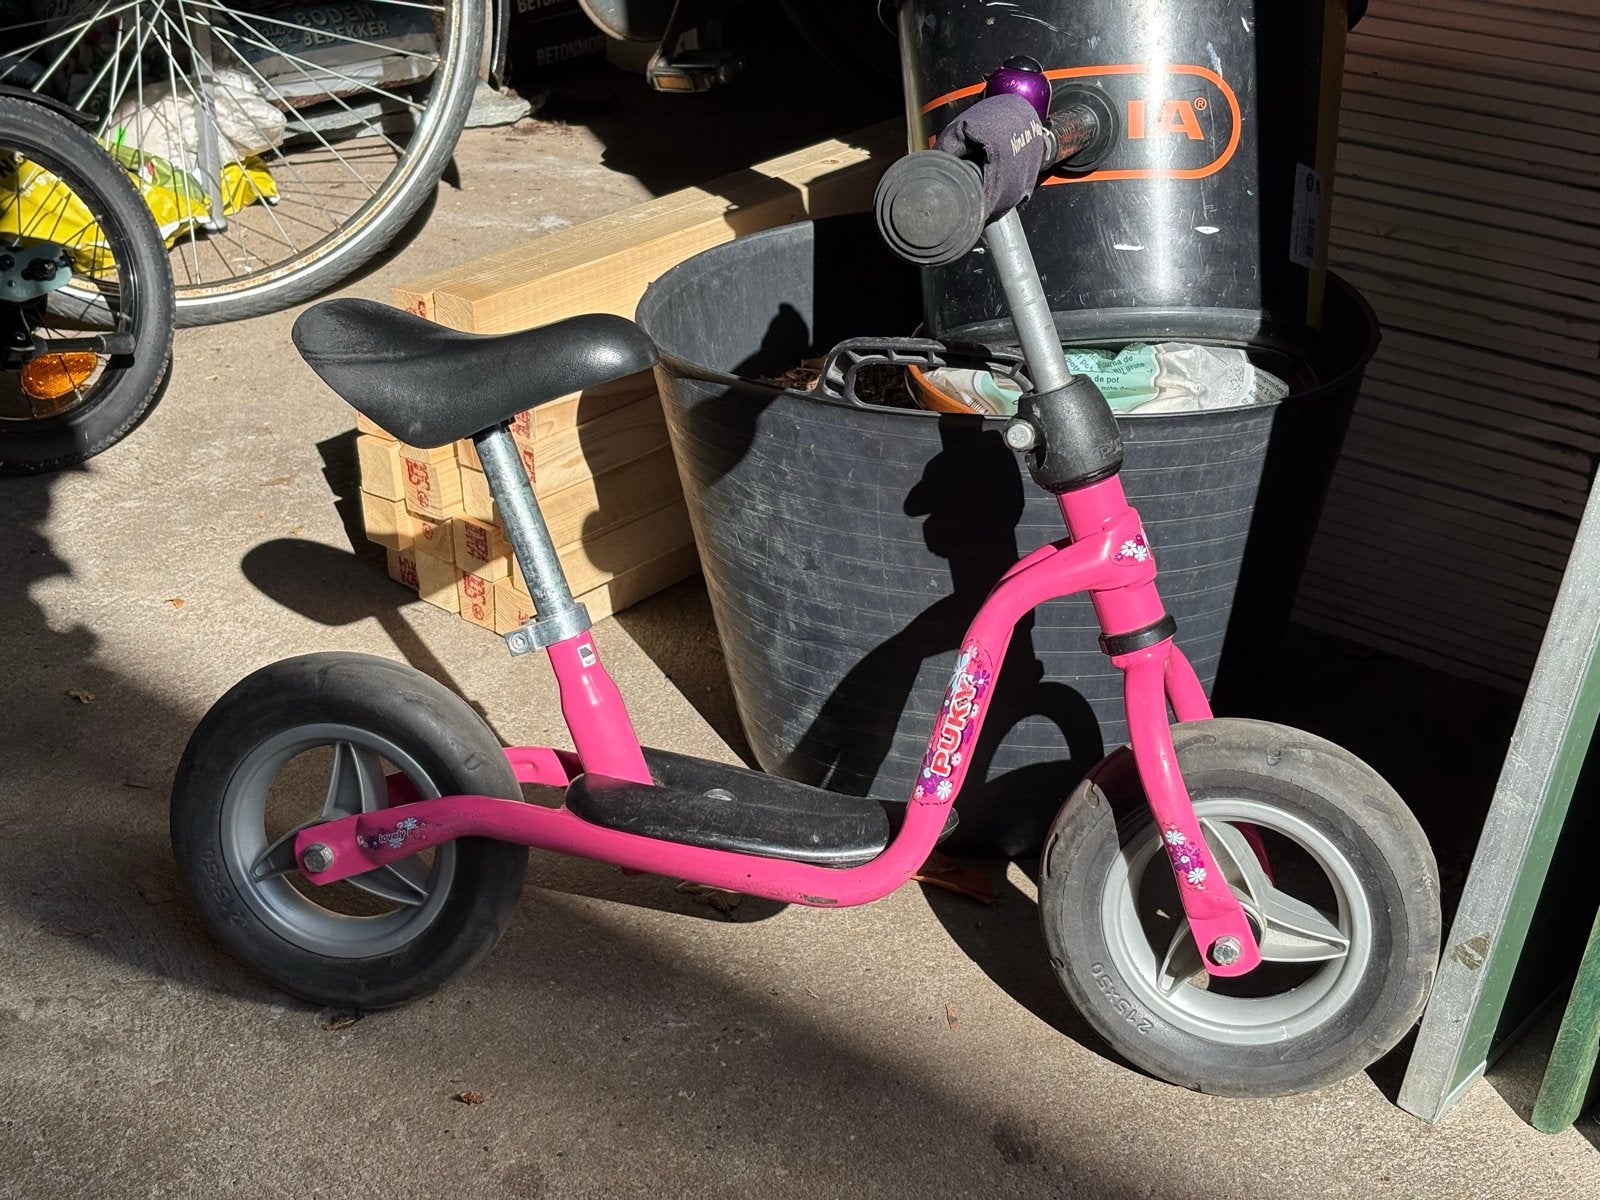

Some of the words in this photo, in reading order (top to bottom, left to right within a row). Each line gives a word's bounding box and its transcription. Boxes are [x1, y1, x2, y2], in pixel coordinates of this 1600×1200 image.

[295, 6, 377, 27] BODEM
[303, 20, 390, 47] BEDEKKER
[929, 672, 977, 778] PUKY
